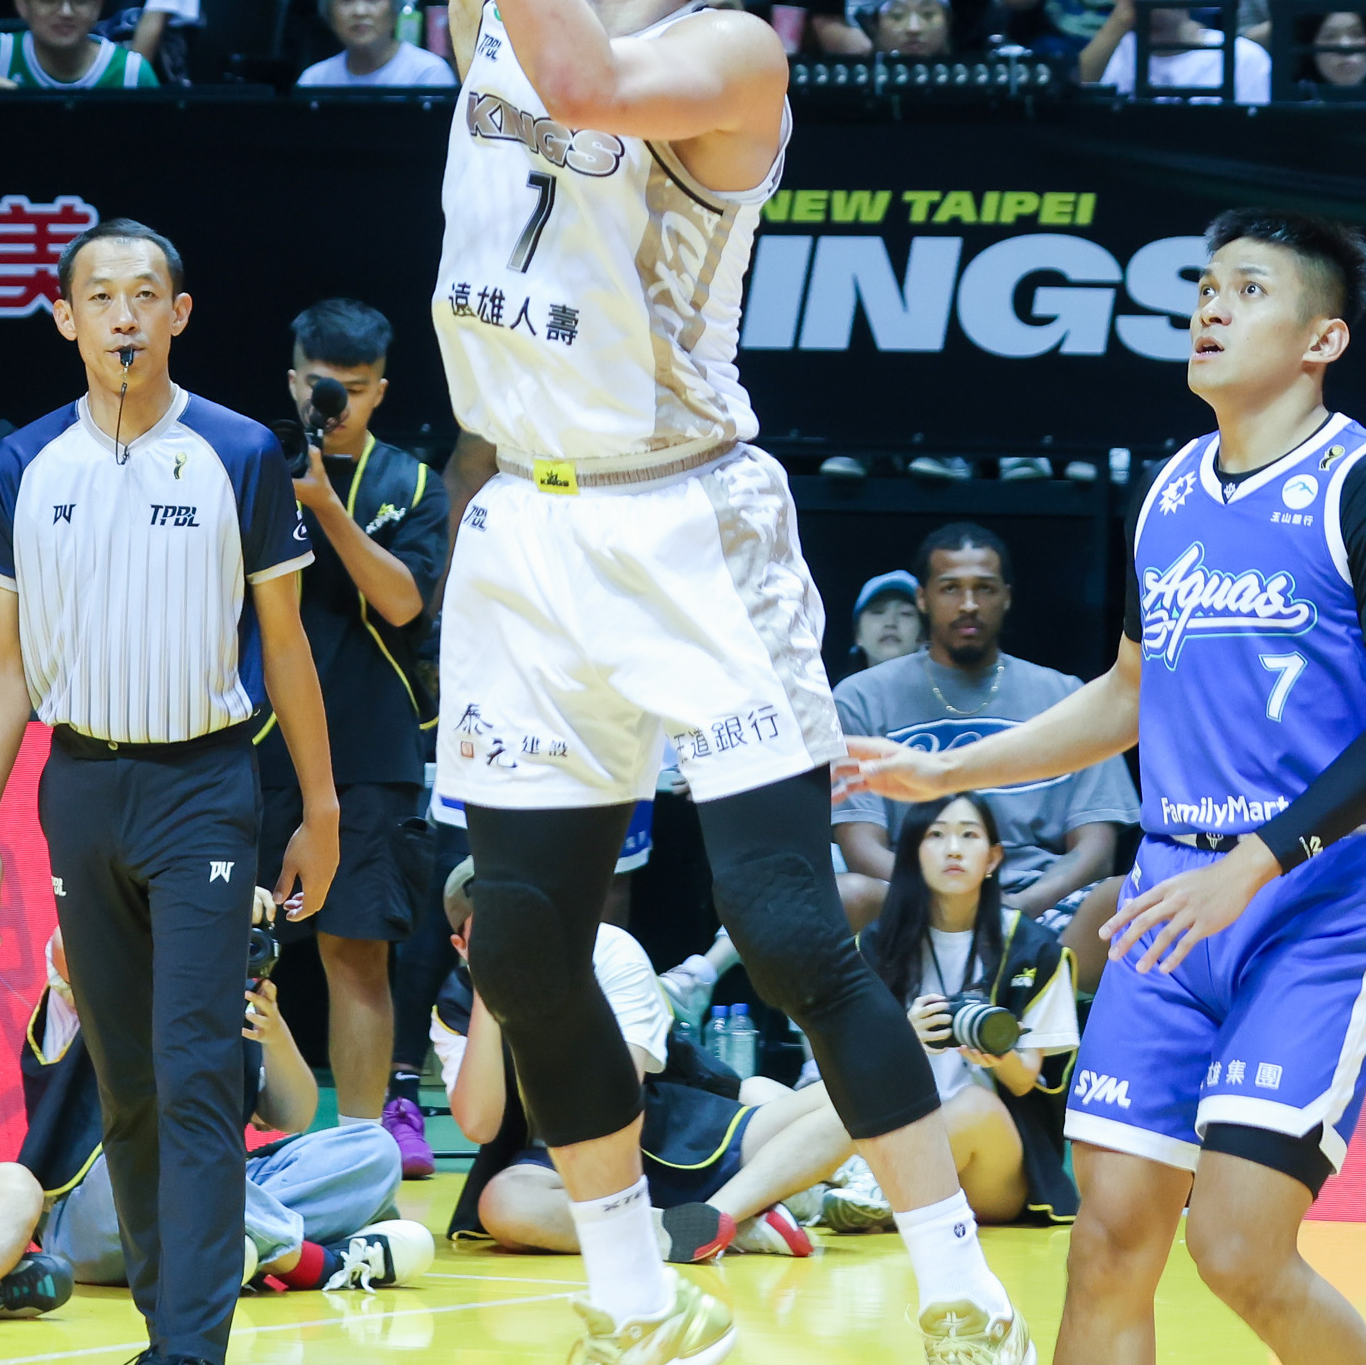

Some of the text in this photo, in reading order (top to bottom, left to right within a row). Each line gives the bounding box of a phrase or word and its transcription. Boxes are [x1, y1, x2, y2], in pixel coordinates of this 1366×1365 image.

[466, 91, 625, 177] KINGS
[507, 170, 557, 273] 7
[761, 189, 1097, 225] NEW TAIPEI
[448, 282, 579, 346] 遠雄人壽
[739, 233, 1209, 362] INGS
[150, 504, 200, 528] TPBL
[1270, 511, 1314, 527] 玉山銀行
[1141, 542, 1318, 671] Aquas
[1258, 652, 1308, 721] 7
[1160, 795, 1290, 828] FamilyMart
[1074, 1069, 1132, 1109] SYM
[1200, 1059, 1283, 1091] 雄集團
